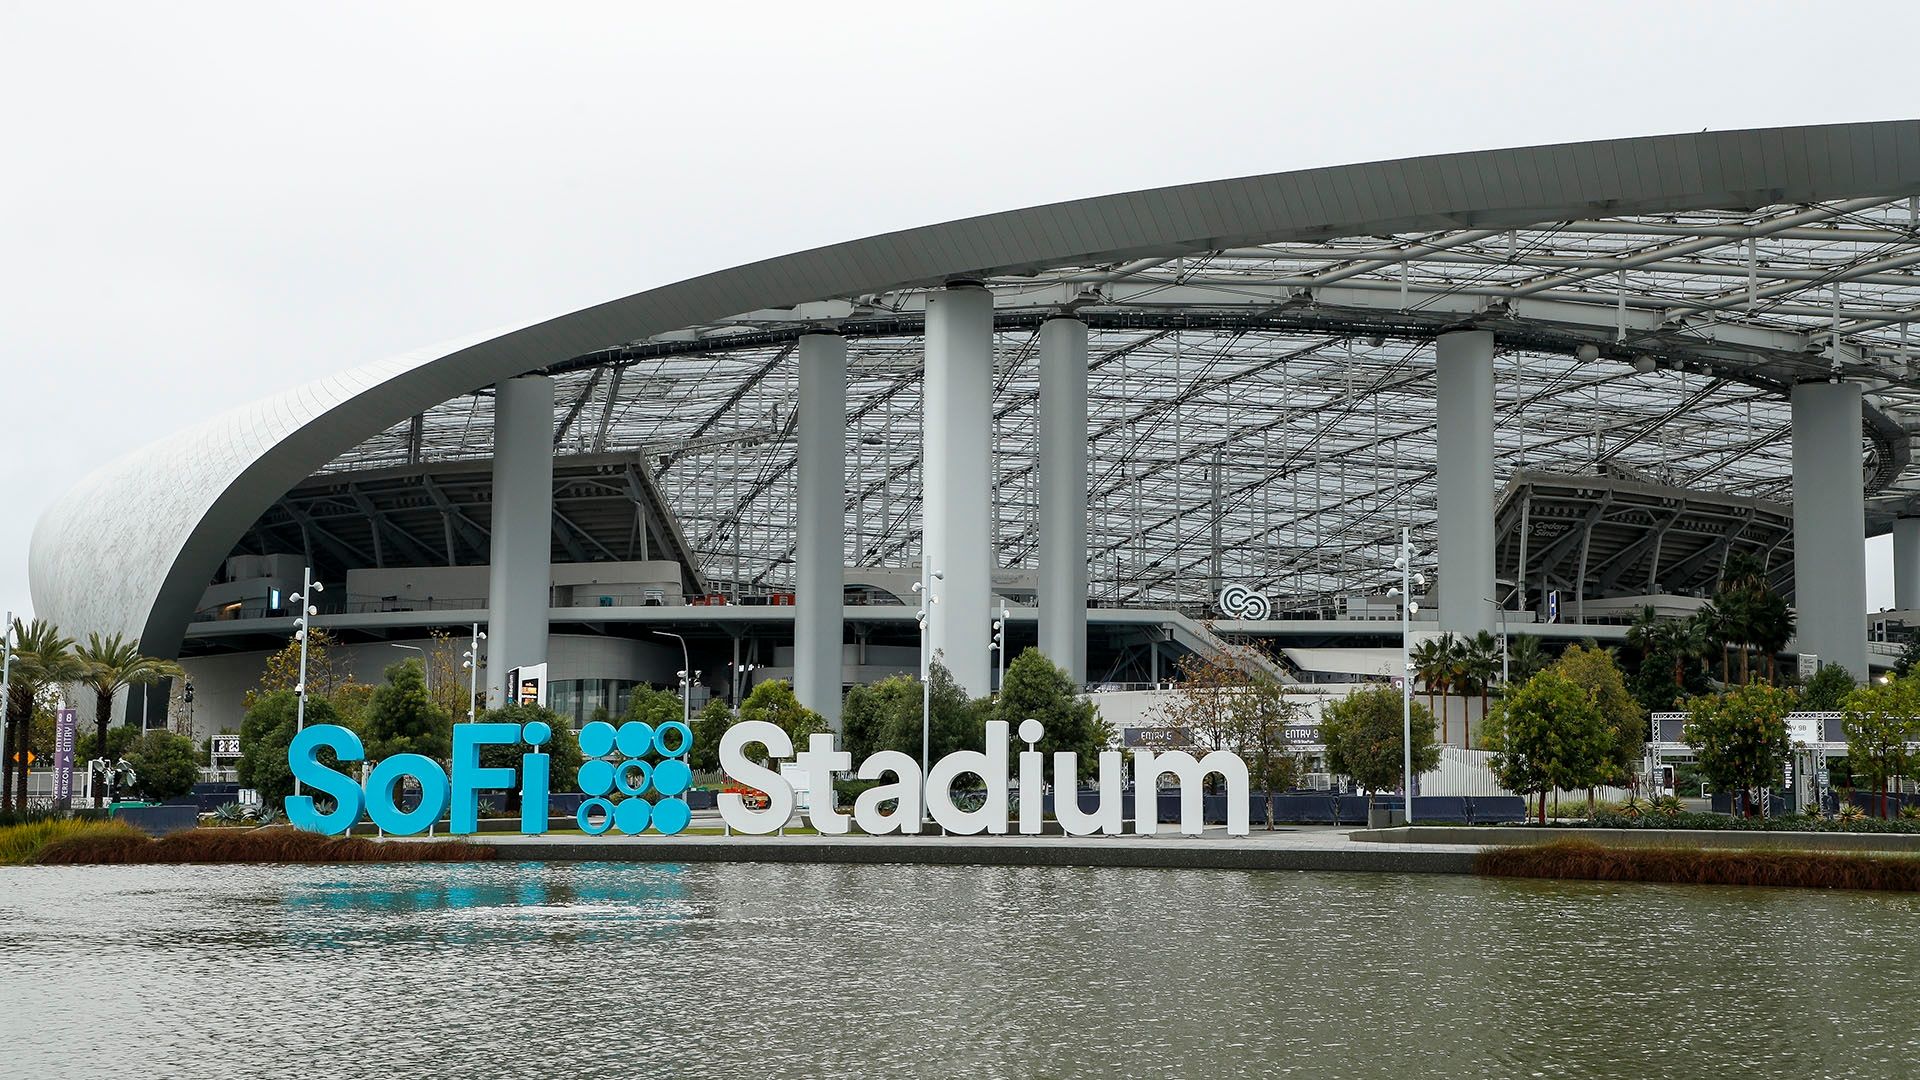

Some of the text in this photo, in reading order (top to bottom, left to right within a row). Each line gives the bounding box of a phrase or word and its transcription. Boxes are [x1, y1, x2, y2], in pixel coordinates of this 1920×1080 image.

[61, 713, 73, 800] VERIZON ENTRY 8
[717, 719, 1250, 836] Stadium
[1140, 731, 1164, 740] ENTRY
[1285, 729, 1311, 739] ENTRY
[285, 721, 551, 836] SoFi
